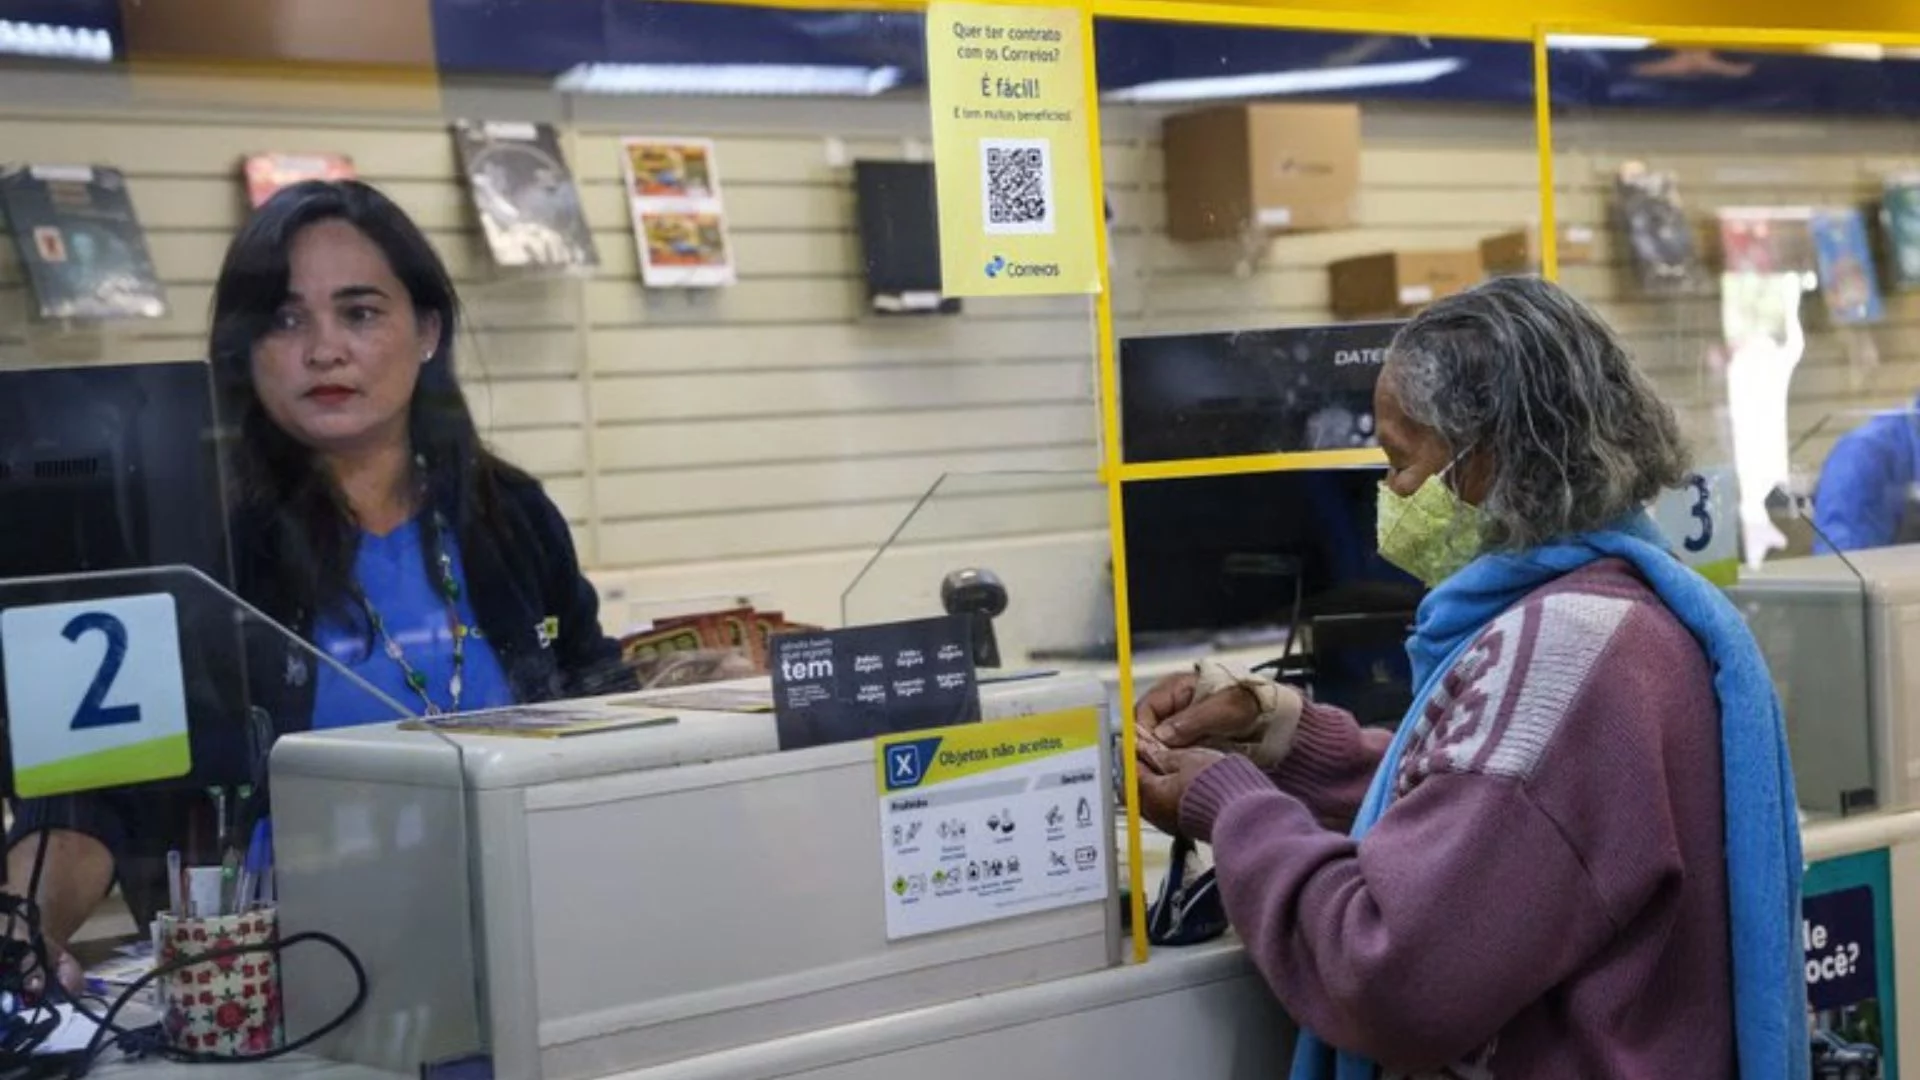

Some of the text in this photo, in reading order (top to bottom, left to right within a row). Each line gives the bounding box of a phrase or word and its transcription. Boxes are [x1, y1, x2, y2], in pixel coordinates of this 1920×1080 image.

[952, 22, 1062, 42] Quer ter contrato
[957, 45, 1061, 62] com os Correios?
[981, 72, 1040, 99] É fácil!
[1007, 262, 1061, 279] Correios
[1334, 347, 1388, 368] DATE
[1683, 473, 1713, 553] 3
[61, 612, 141, 731] 2
[781, 659, 834, 682] tem
[939, 737, 1063, 768] Objetos não aceitos
[1802, 919, 1829, 951] le
[1805, 942, 1860, 983] ocê?
